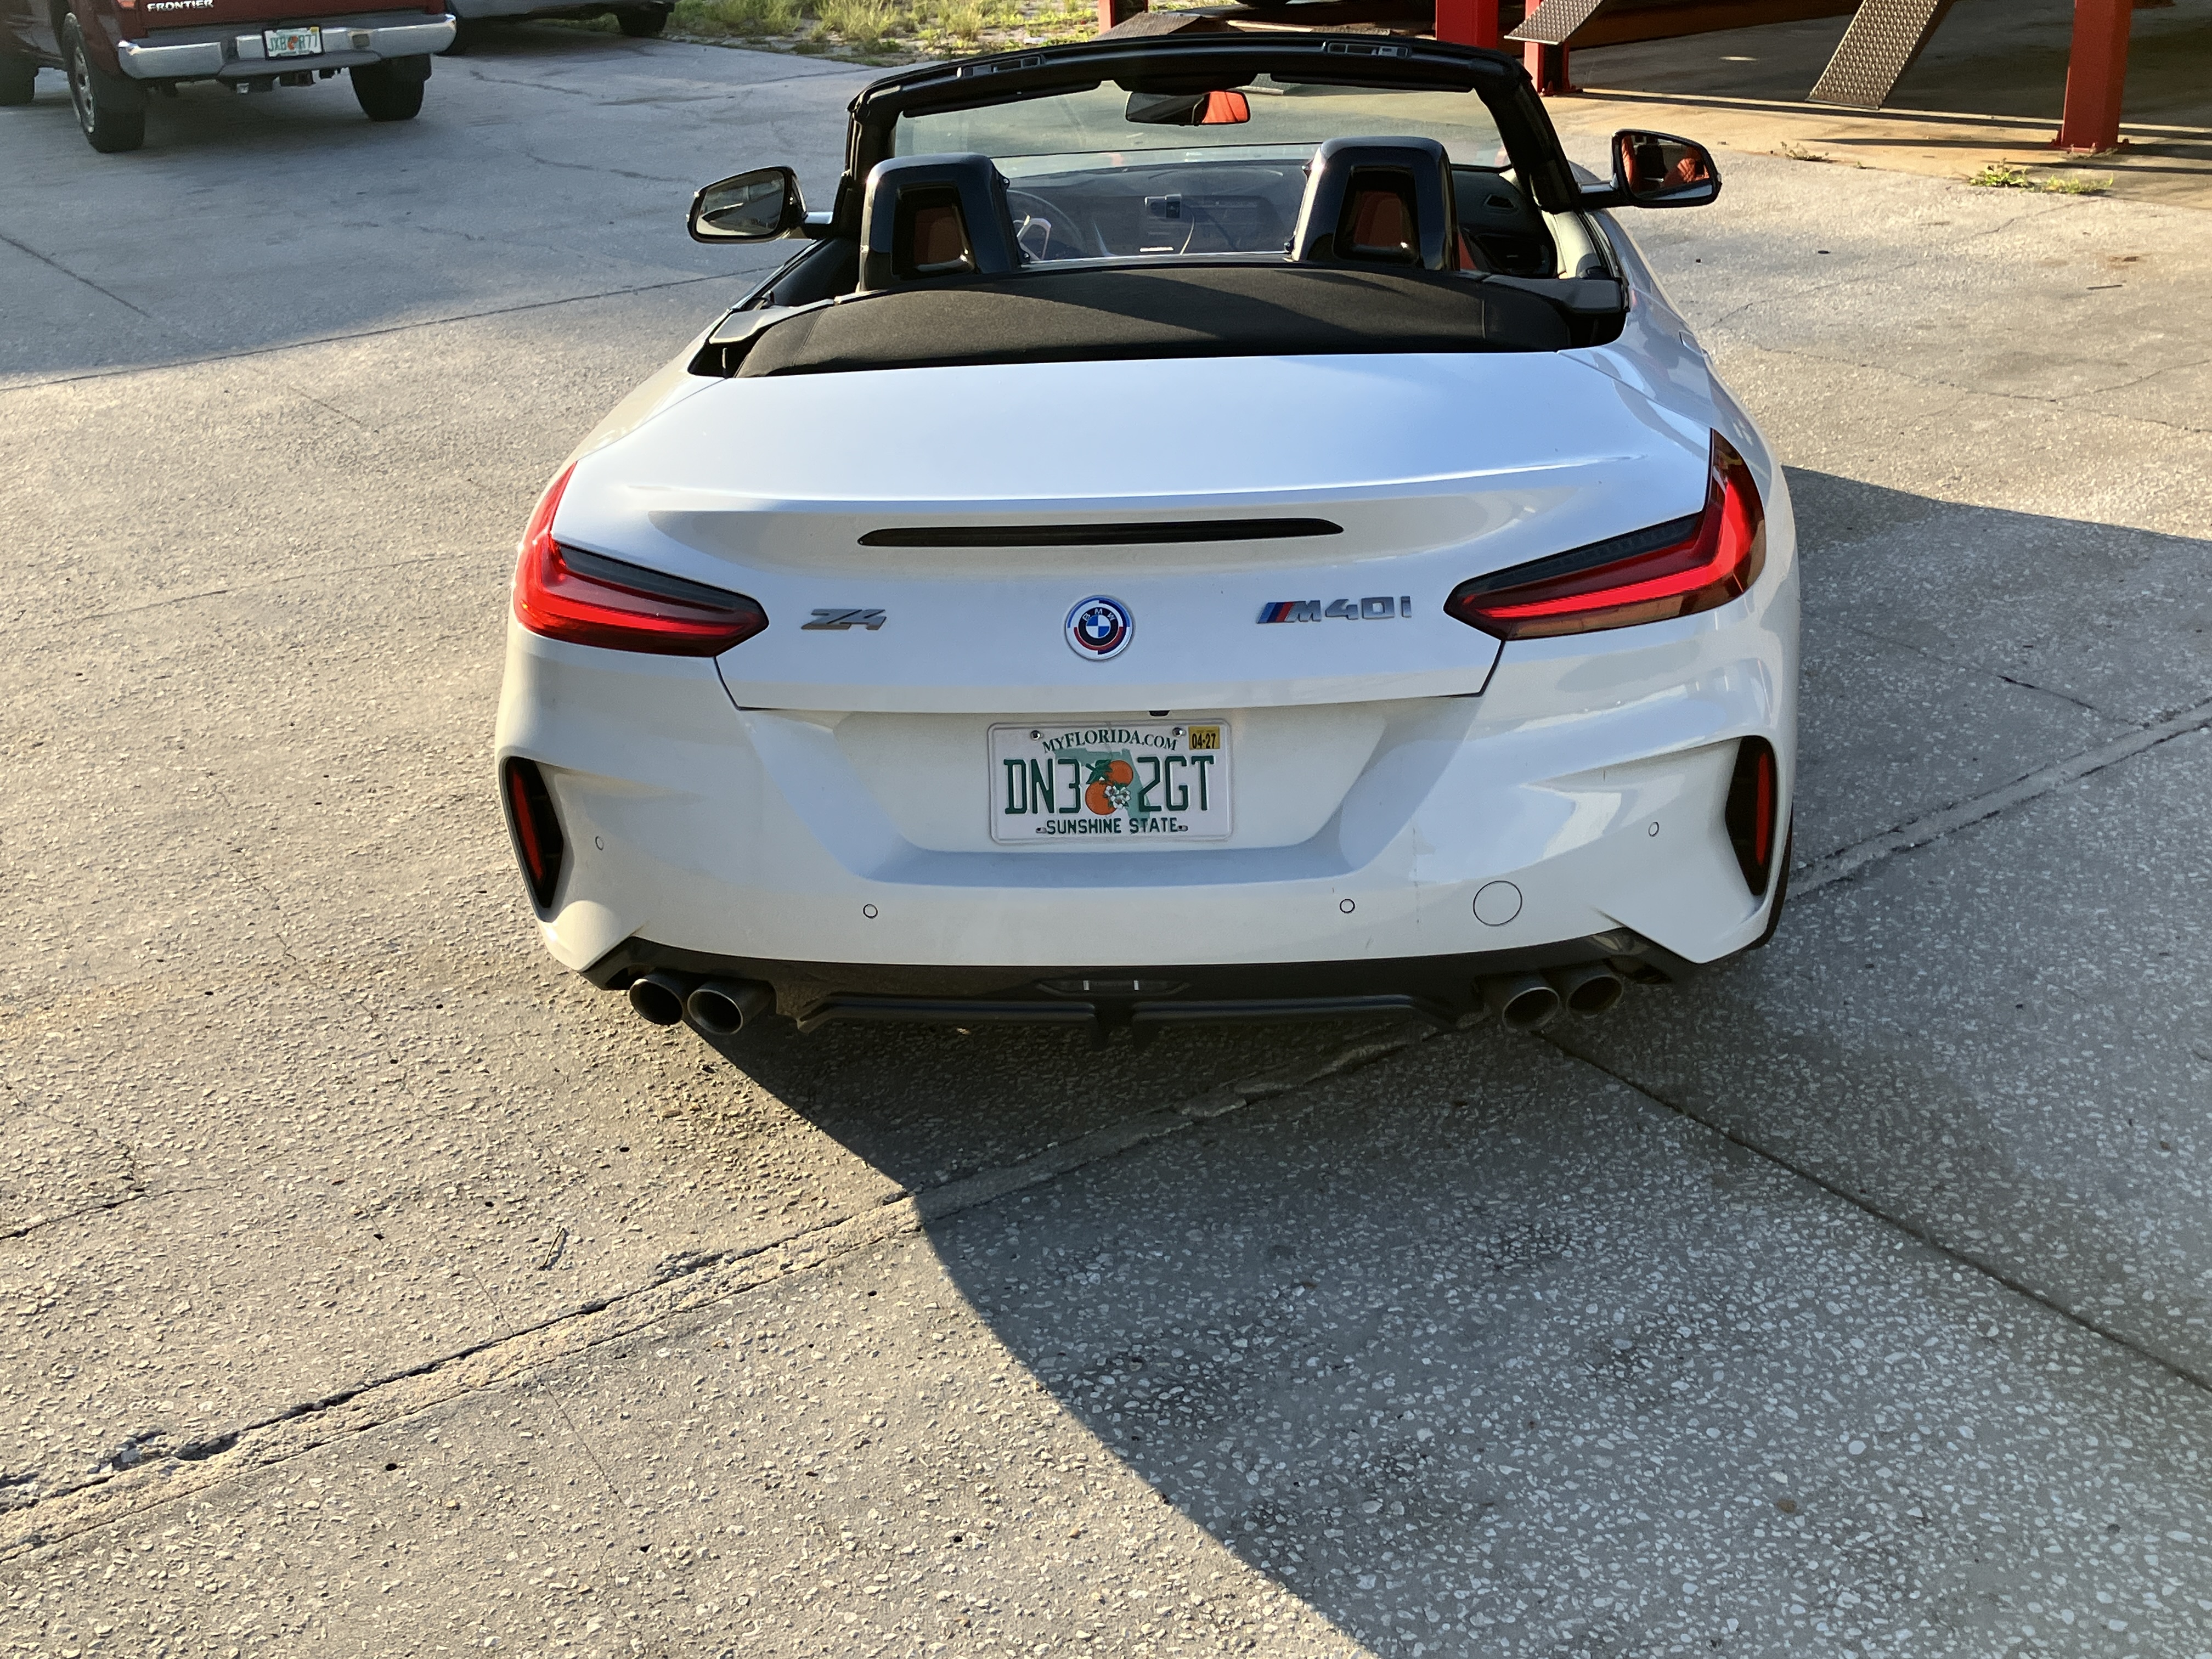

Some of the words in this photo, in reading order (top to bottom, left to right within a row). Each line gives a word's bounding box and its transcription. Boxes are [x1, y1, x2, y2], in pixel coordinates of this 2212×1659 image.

[147, 0, 213, 12] FRONTIER
[801, 609, 887, 630] Z4
[1082, 608, 1116, 622] BMW
[1042, 729, 1177, 753] MYFLORIDA.COM
[1046, 817, 1121, 834] SUNSHINE
[1130, 817, 1178, 834] STATE
